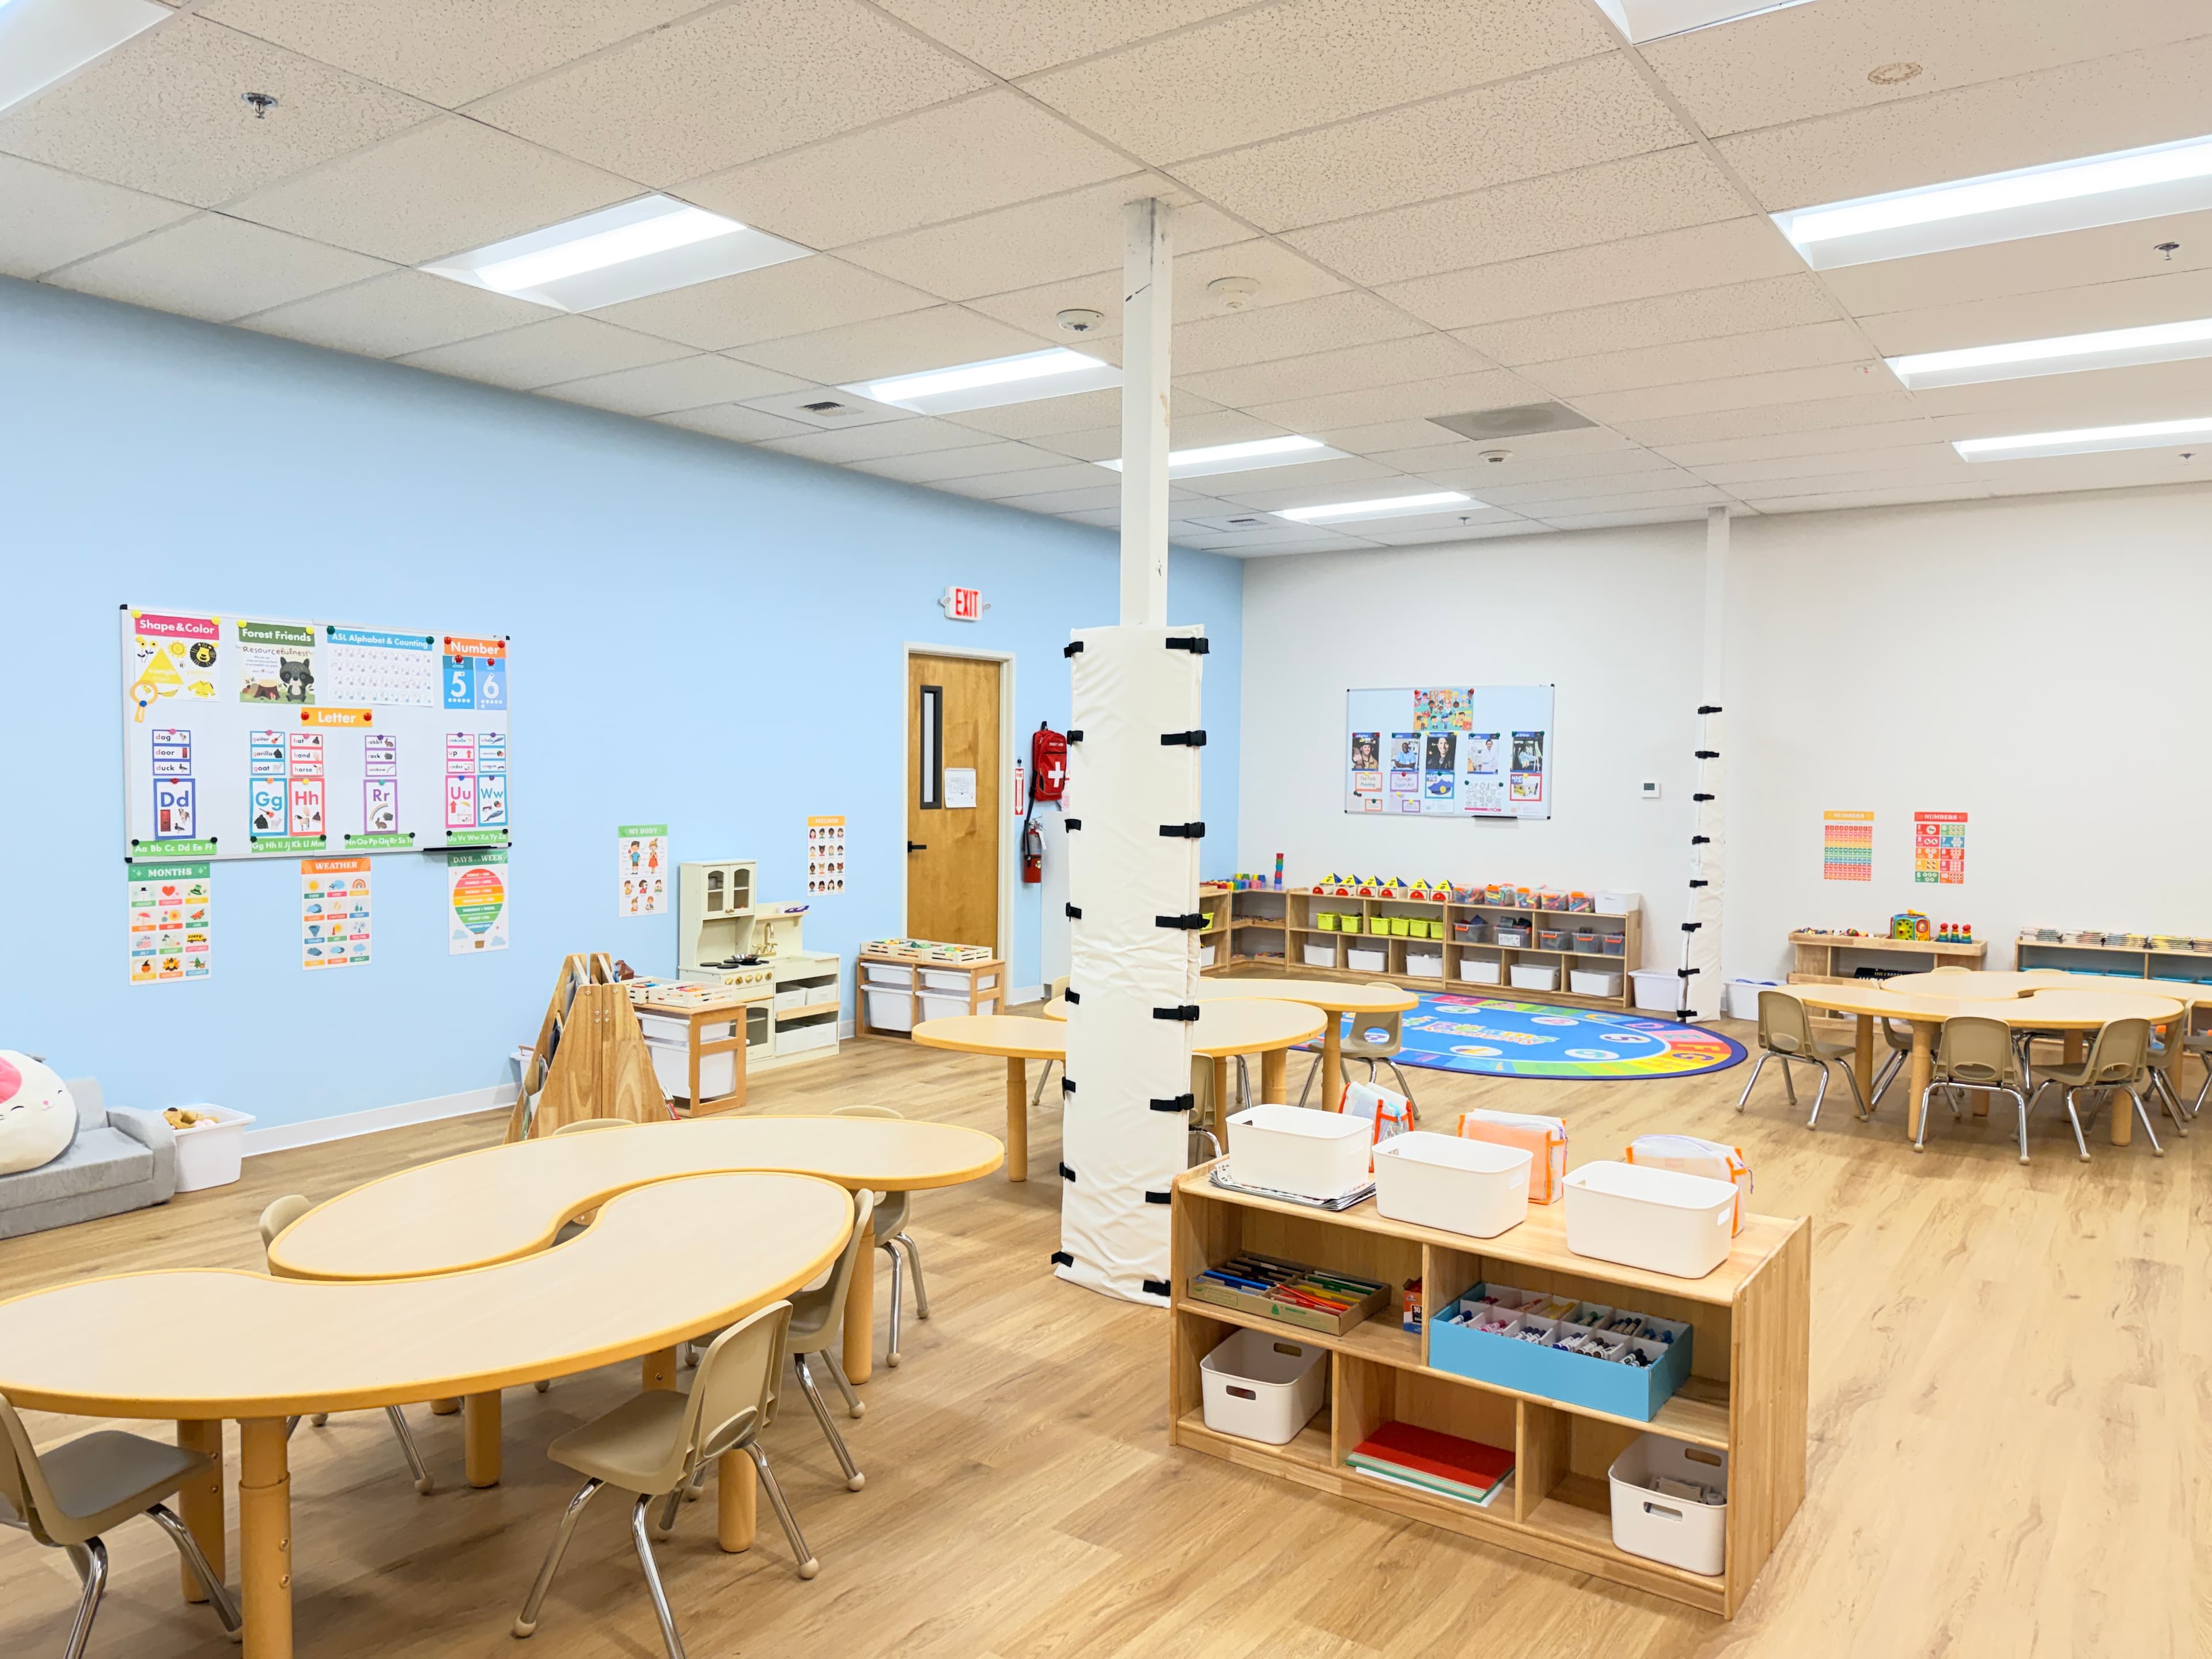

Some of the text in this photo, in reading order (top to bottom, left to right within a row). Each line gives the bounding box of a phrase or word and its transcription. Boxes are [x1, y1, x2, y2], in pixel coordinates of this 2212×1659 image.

[955, 588, 978, 618] EXIT
[242, 628, 312, 642] Forest Friends
[332, 633, 347, 641] ASL
[349, 634, 385, 645] Alphabet
[394, 638, 428, 649] Counting
[243, 646, 309, 657] Resourcefulness
[450, 642, 499, 654] Number
[450, 671, 467, 698] 5
[483, 672, 499, 699] 6
[318, 711, 357, 724] Letter
[156, 733, 171, 741] dog
[161, 790, 189, 807] Dd
[294, 791, 319, 805] Hh
[373, 789, 390, 802] Rr
[450, 786, 471, 800] Uu
[480, 787, 503, 799] Ww
[255, 791, 282, 810] Gg
[252, 843, 264, 851] Gg
[284, 842, 290, 851] Jj
[303, 839, 309, 847] Ll
[310, 839, 325, 847] Mm
[369, 838, 378, 847] Pp
[378, 838, 390, 847] Qq
[315, 861, 357, 870] WEATHER
[148, 868, 192, 877] MONTHS
